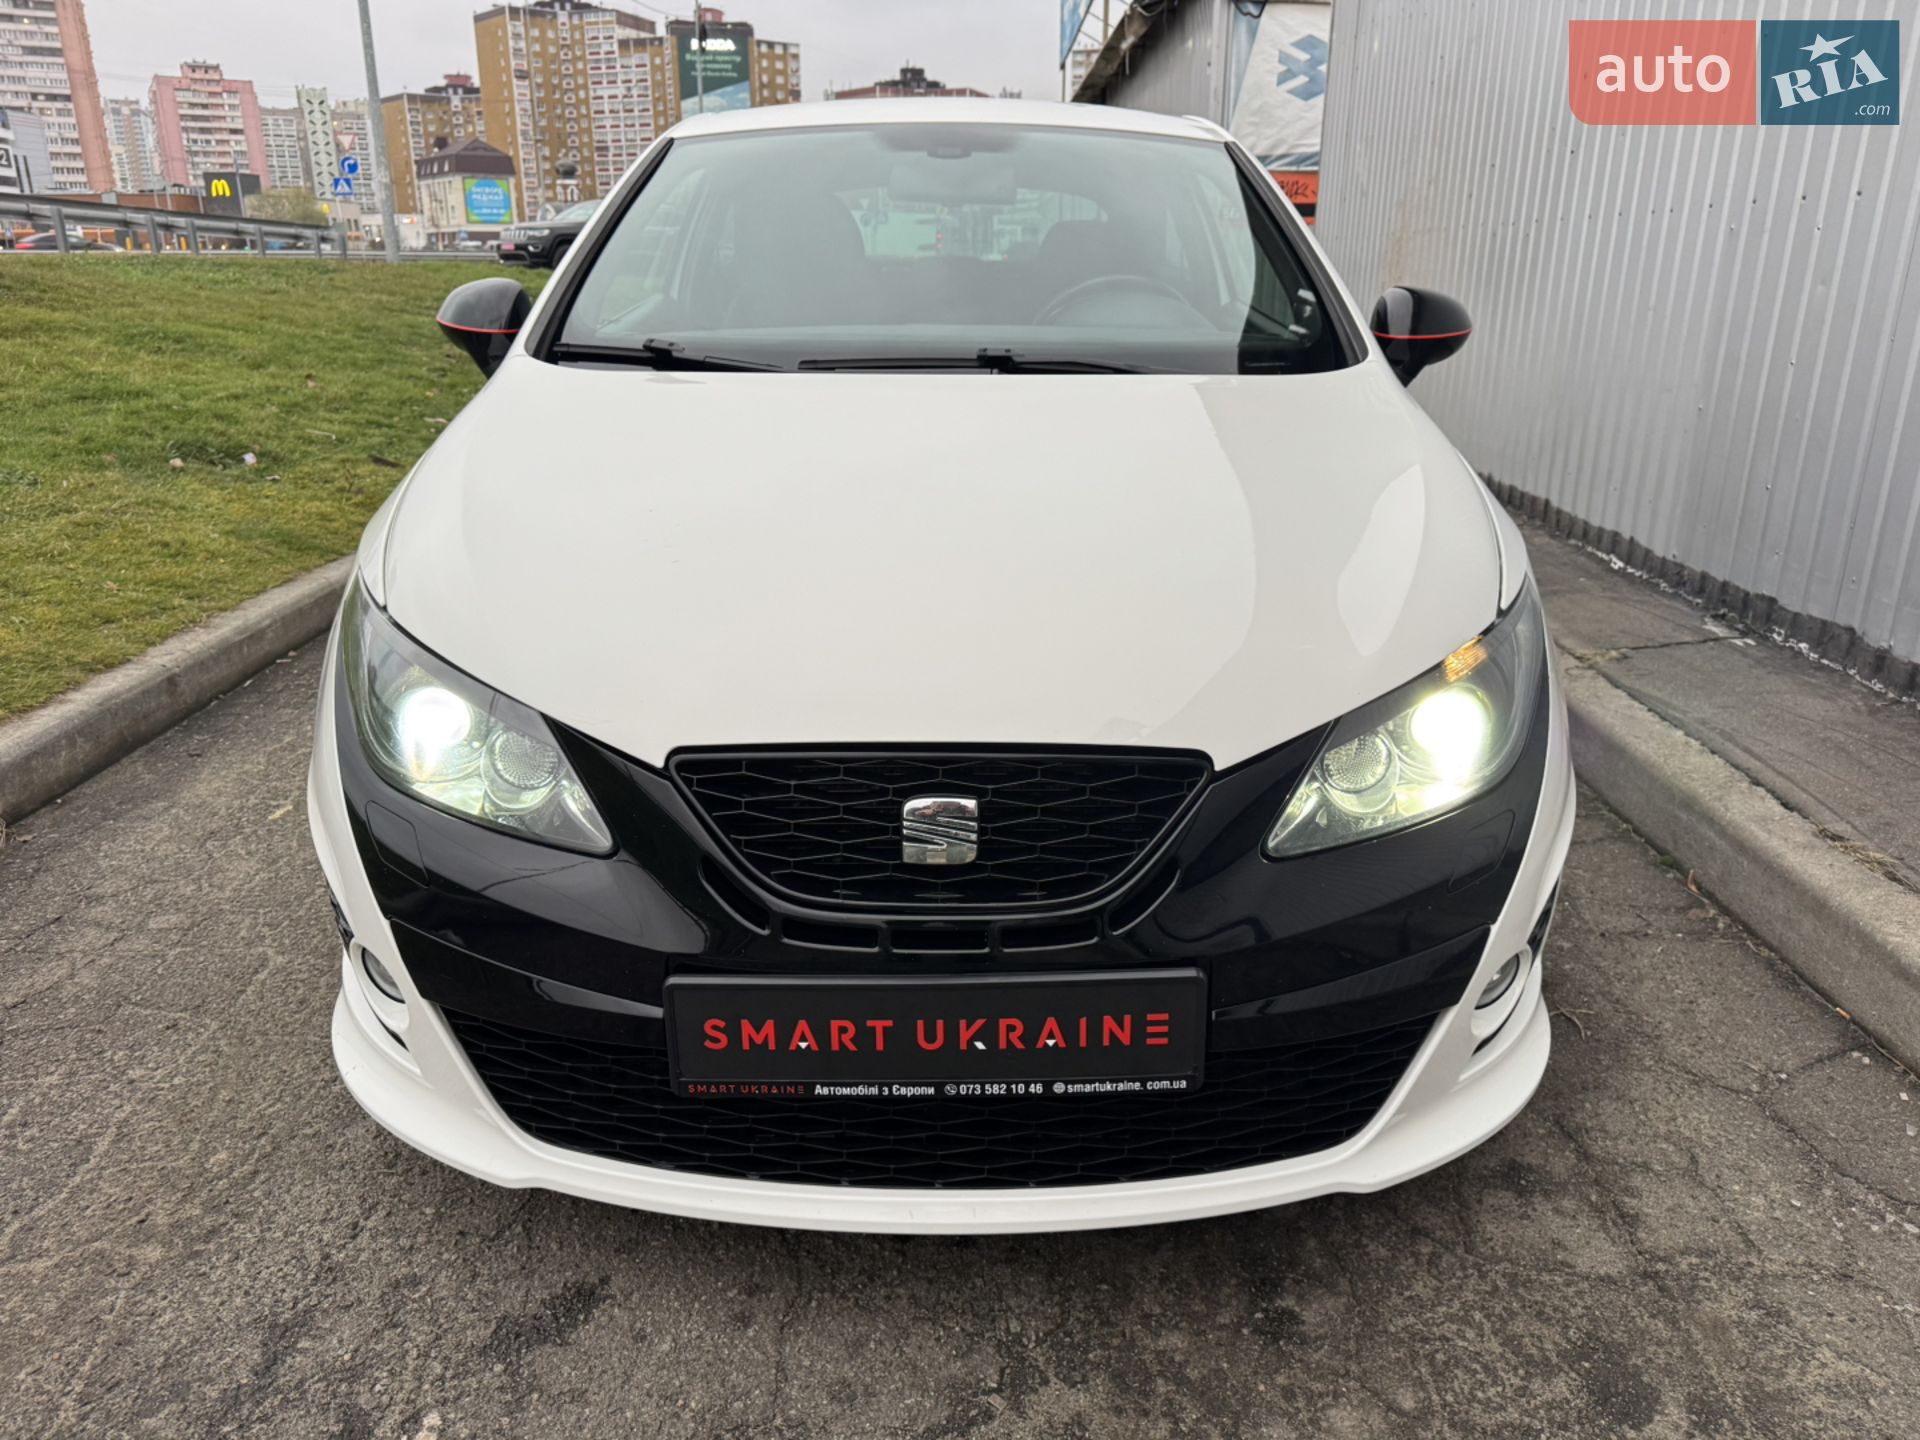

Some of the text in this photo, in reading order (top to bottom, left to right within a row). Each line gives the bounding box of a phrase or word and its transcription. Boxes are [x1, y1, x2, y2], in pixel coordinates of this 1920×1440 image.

[703, 1012, 1170, 1052] SMART UKRAINE
[687, 1084, 806, 1095] SMART UKRAINE
[814, 1084, 935, 1098] Автомобілі з Європи
[959, 1083, 1044, 1095] 073 582 10 46
